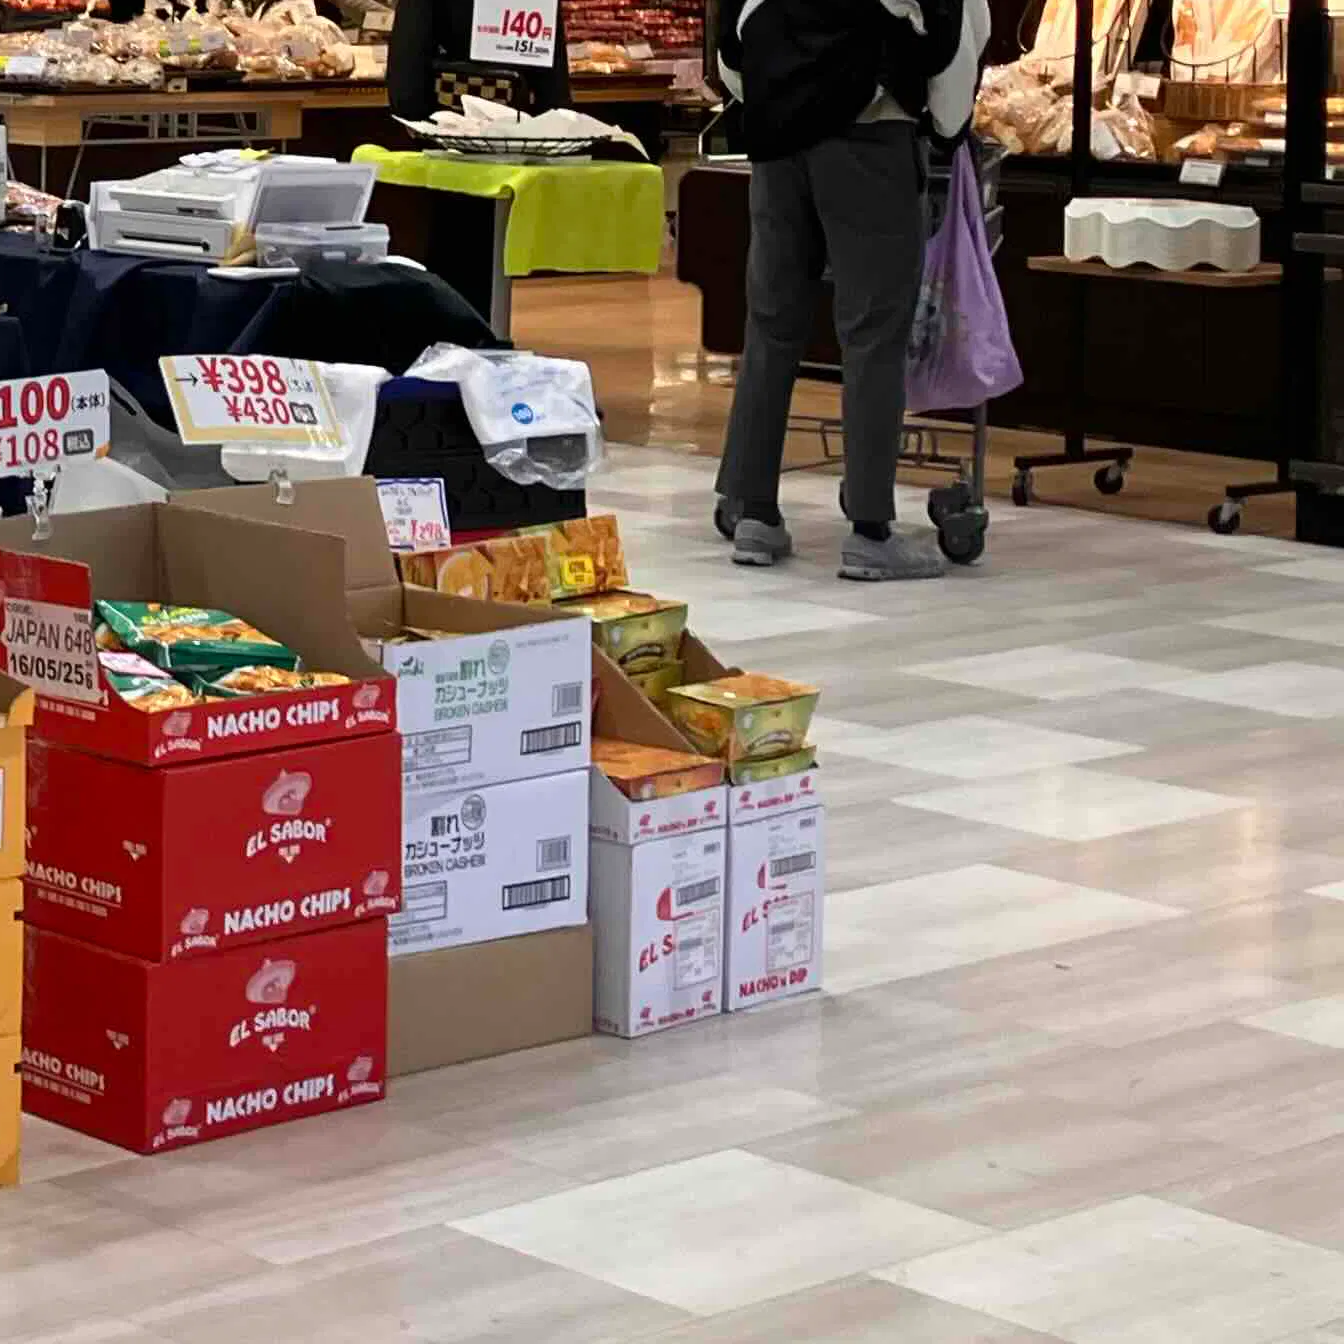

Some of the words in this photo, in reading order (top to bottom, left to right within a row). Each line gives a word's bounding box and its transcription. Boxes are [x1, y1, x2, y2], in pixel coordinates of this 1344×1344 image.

[195, 355, 288, 396] ¥398
[71, 392, 106, 413] (本体)
[222, 395, 291, 425] ¥430
[4, 616, 61, 651] JAPAN
[62, 624, 94, 656] 648
[10, 652, 85, 687] 16/05/25
[434, 677, 510, 705] カシューナッツ
[207, 707, 282, 740] NACHO
[285, 697, 341, 727] CHIPS
[245, 832, 268, 858] EL
[269, 819, 328, 844] SABOR
[430, 813, 460, 837] 割れ
[405, 831, 486, 861] カシューナッツ
[404, 859, 444, 879] BROKEN
[80, 876, 122, 904] CHIPS
[223, 899, 296, 936] NACHO
[299, 887, 352, 918] CHIPS
[741, 905, 759, 934] EL
[638, 943, 658, 974] EL
[738, 975, 779, 998] NACHO
[788, 967, 809, 987] DIP
[228, 1020, 252, 1048] EL
[253, 1006, 311, 1032] SABOR
[21, 1045, 62, 1075] ACHO
[64, 1062, 105, 1091] CHIPS
[206, 1087, 278, 1125] NACHO
[282, 1073, 335, 1105] CHIPS
